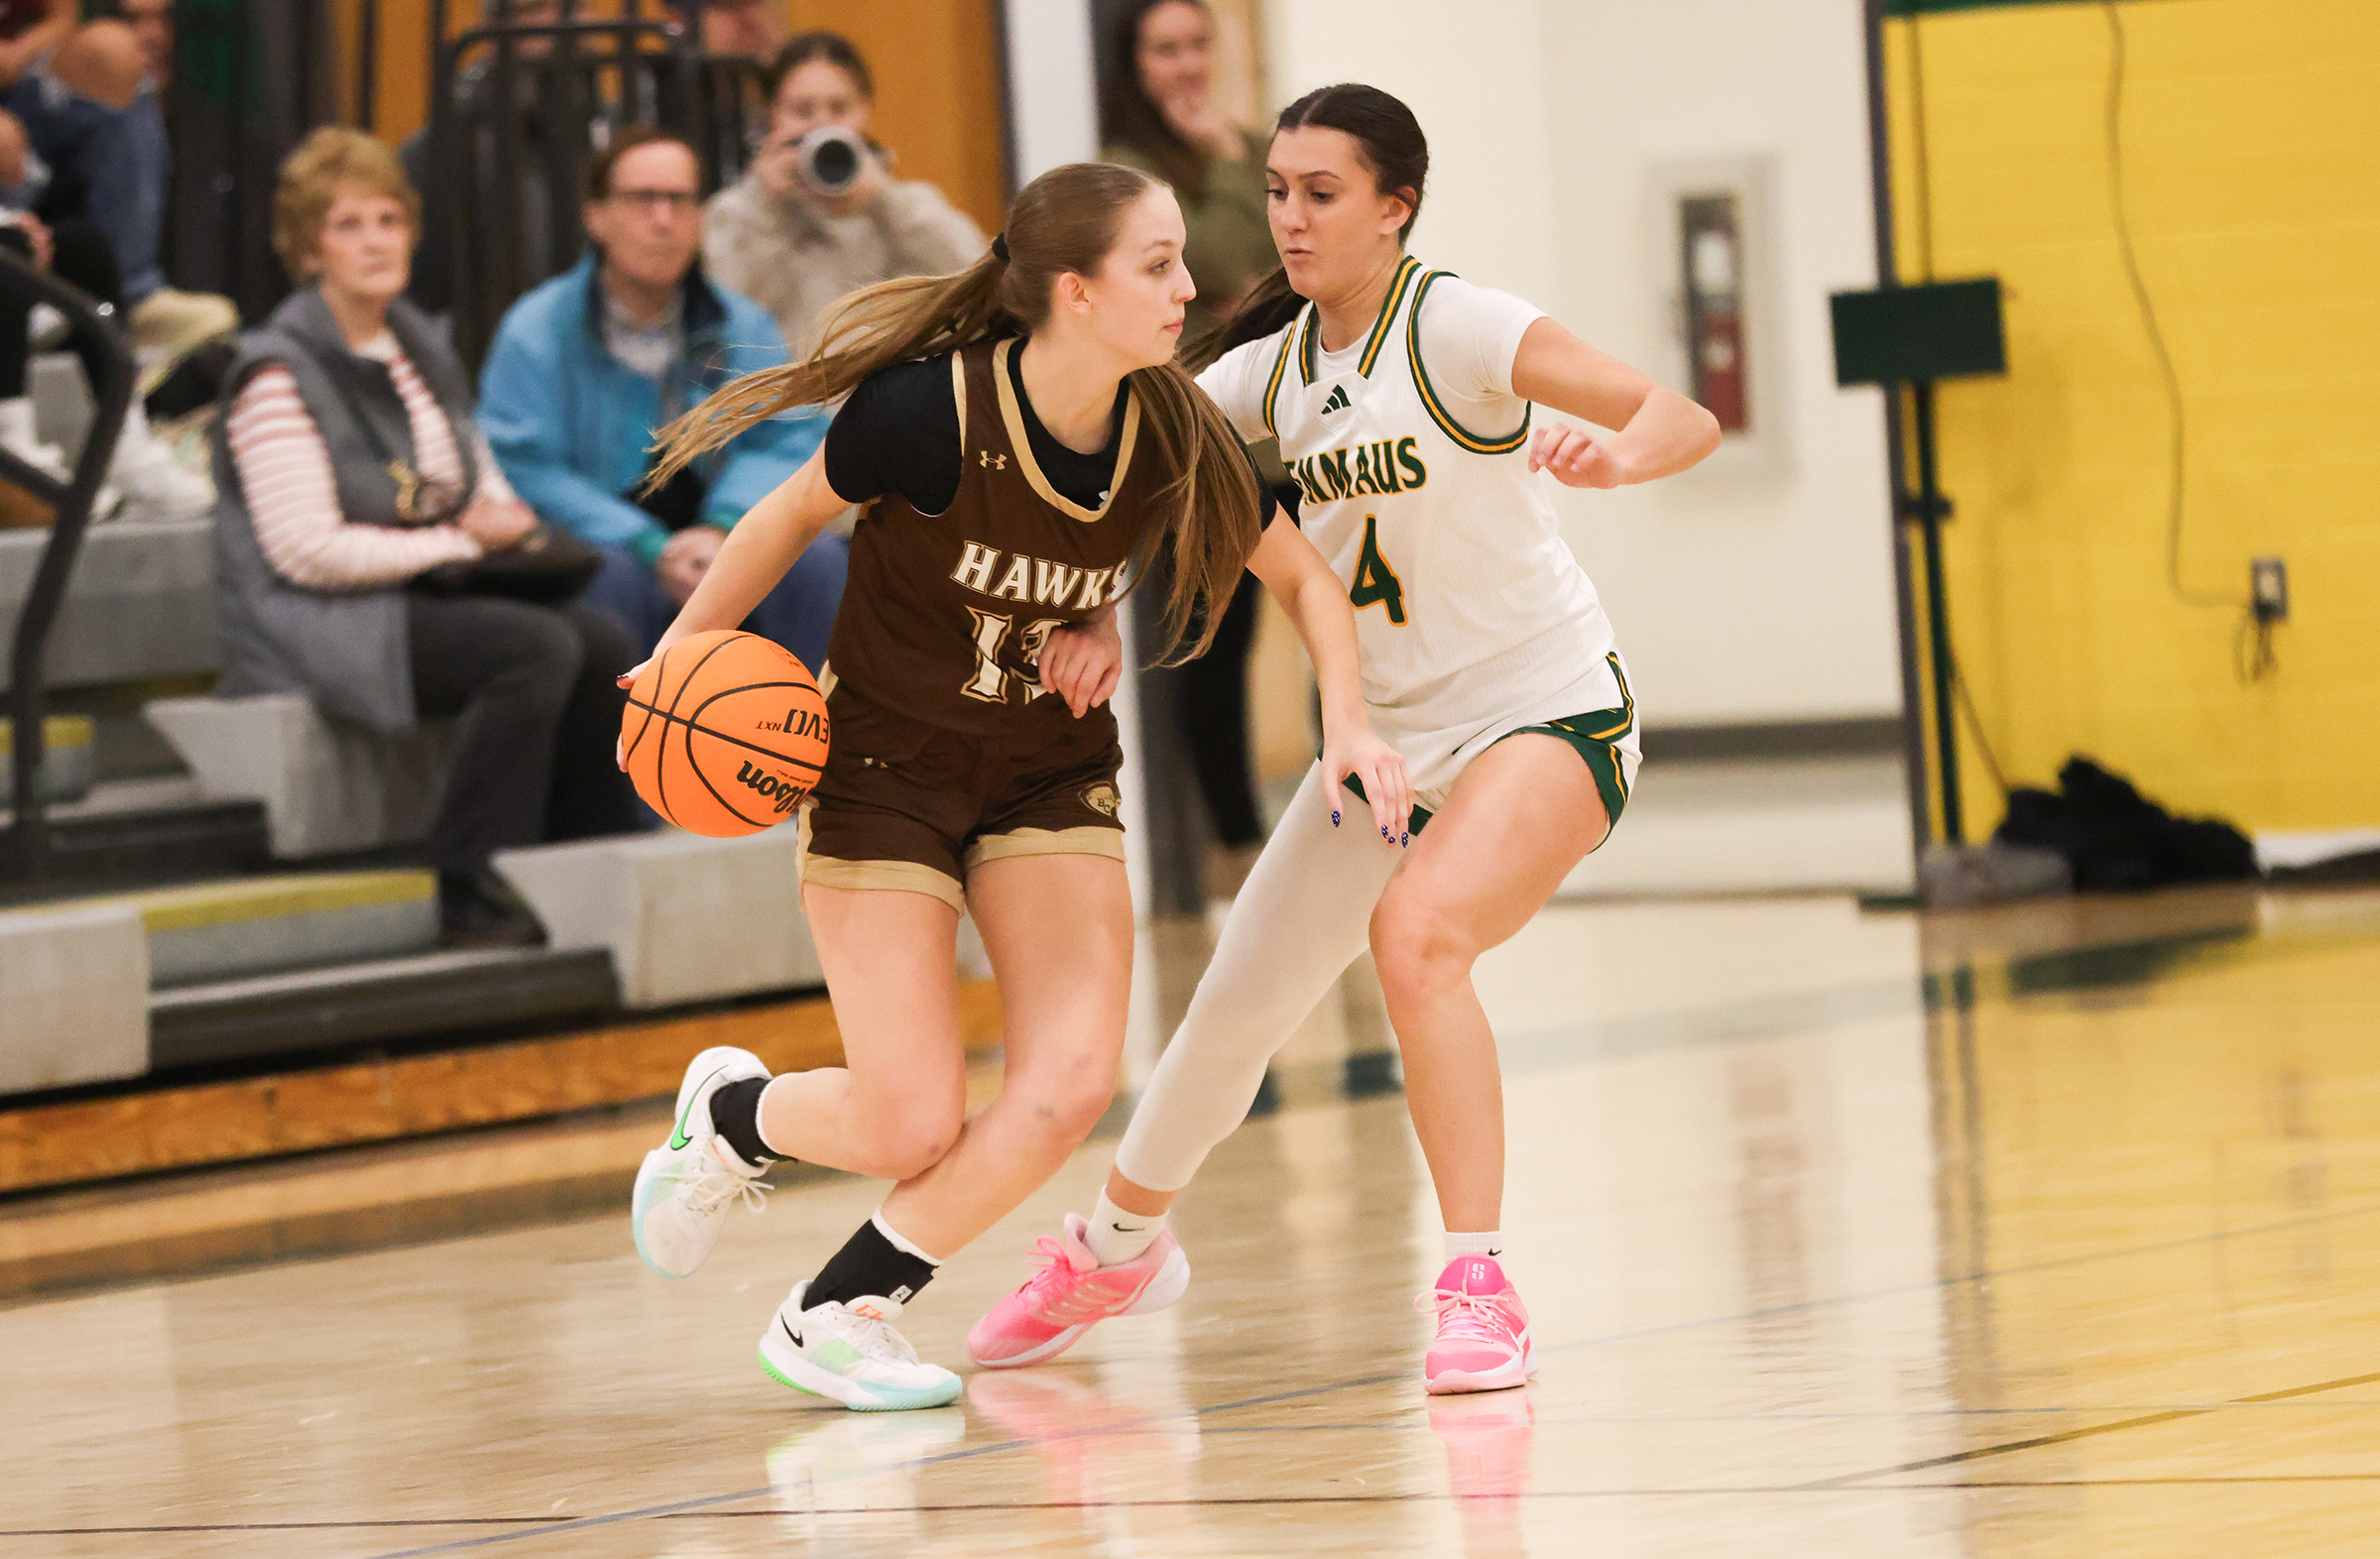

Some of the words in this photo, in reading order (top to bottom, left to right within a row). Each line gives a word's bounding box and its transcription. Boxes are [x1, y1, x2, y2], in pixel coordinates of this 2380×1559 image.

[1350, 513, 1409, 627] 4
[756, 720, 782, 732] NXT
[737, 760, 810, 814] ilson
